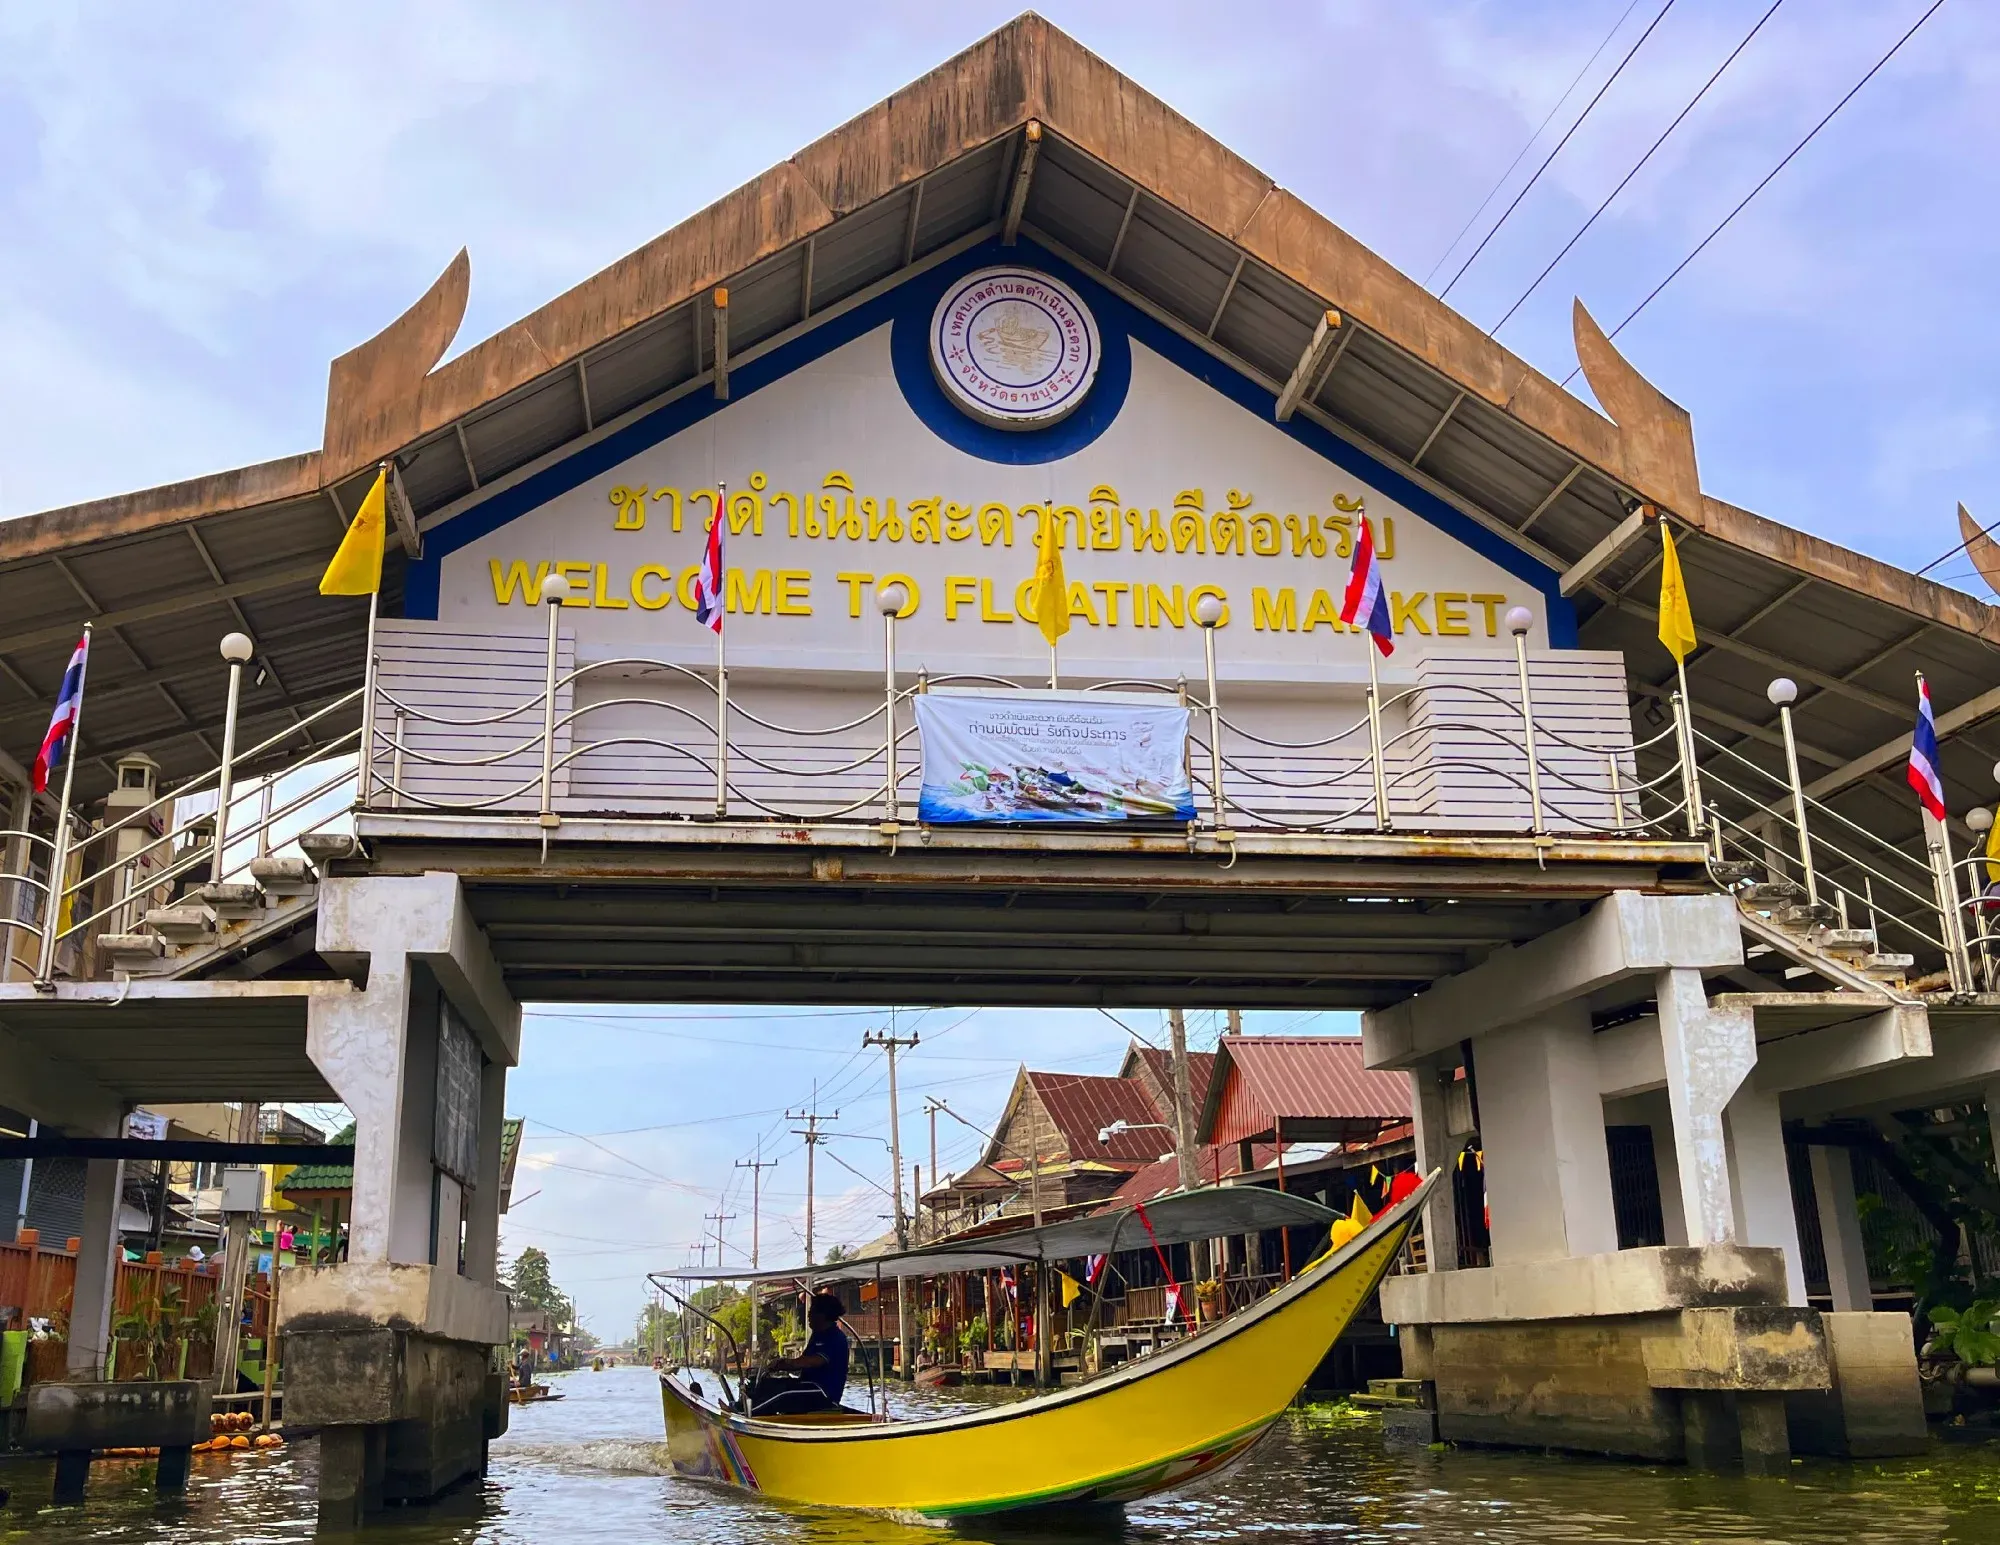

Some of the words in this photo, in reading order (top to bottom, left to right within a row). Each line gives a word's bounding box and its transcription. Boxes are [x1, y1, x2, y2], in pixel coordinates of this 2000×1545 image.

[950, 282, 1081, 363] เทศบาลตำบลดำเนินสะดวก
[961, 364, 1060, 403] จังหวัดราชบุรี
[836, 572, 920, 619] TO
[1251, 586, 1507, 637] MAKET
[1047, 724, 1127, 741] รัชกิจประการ
